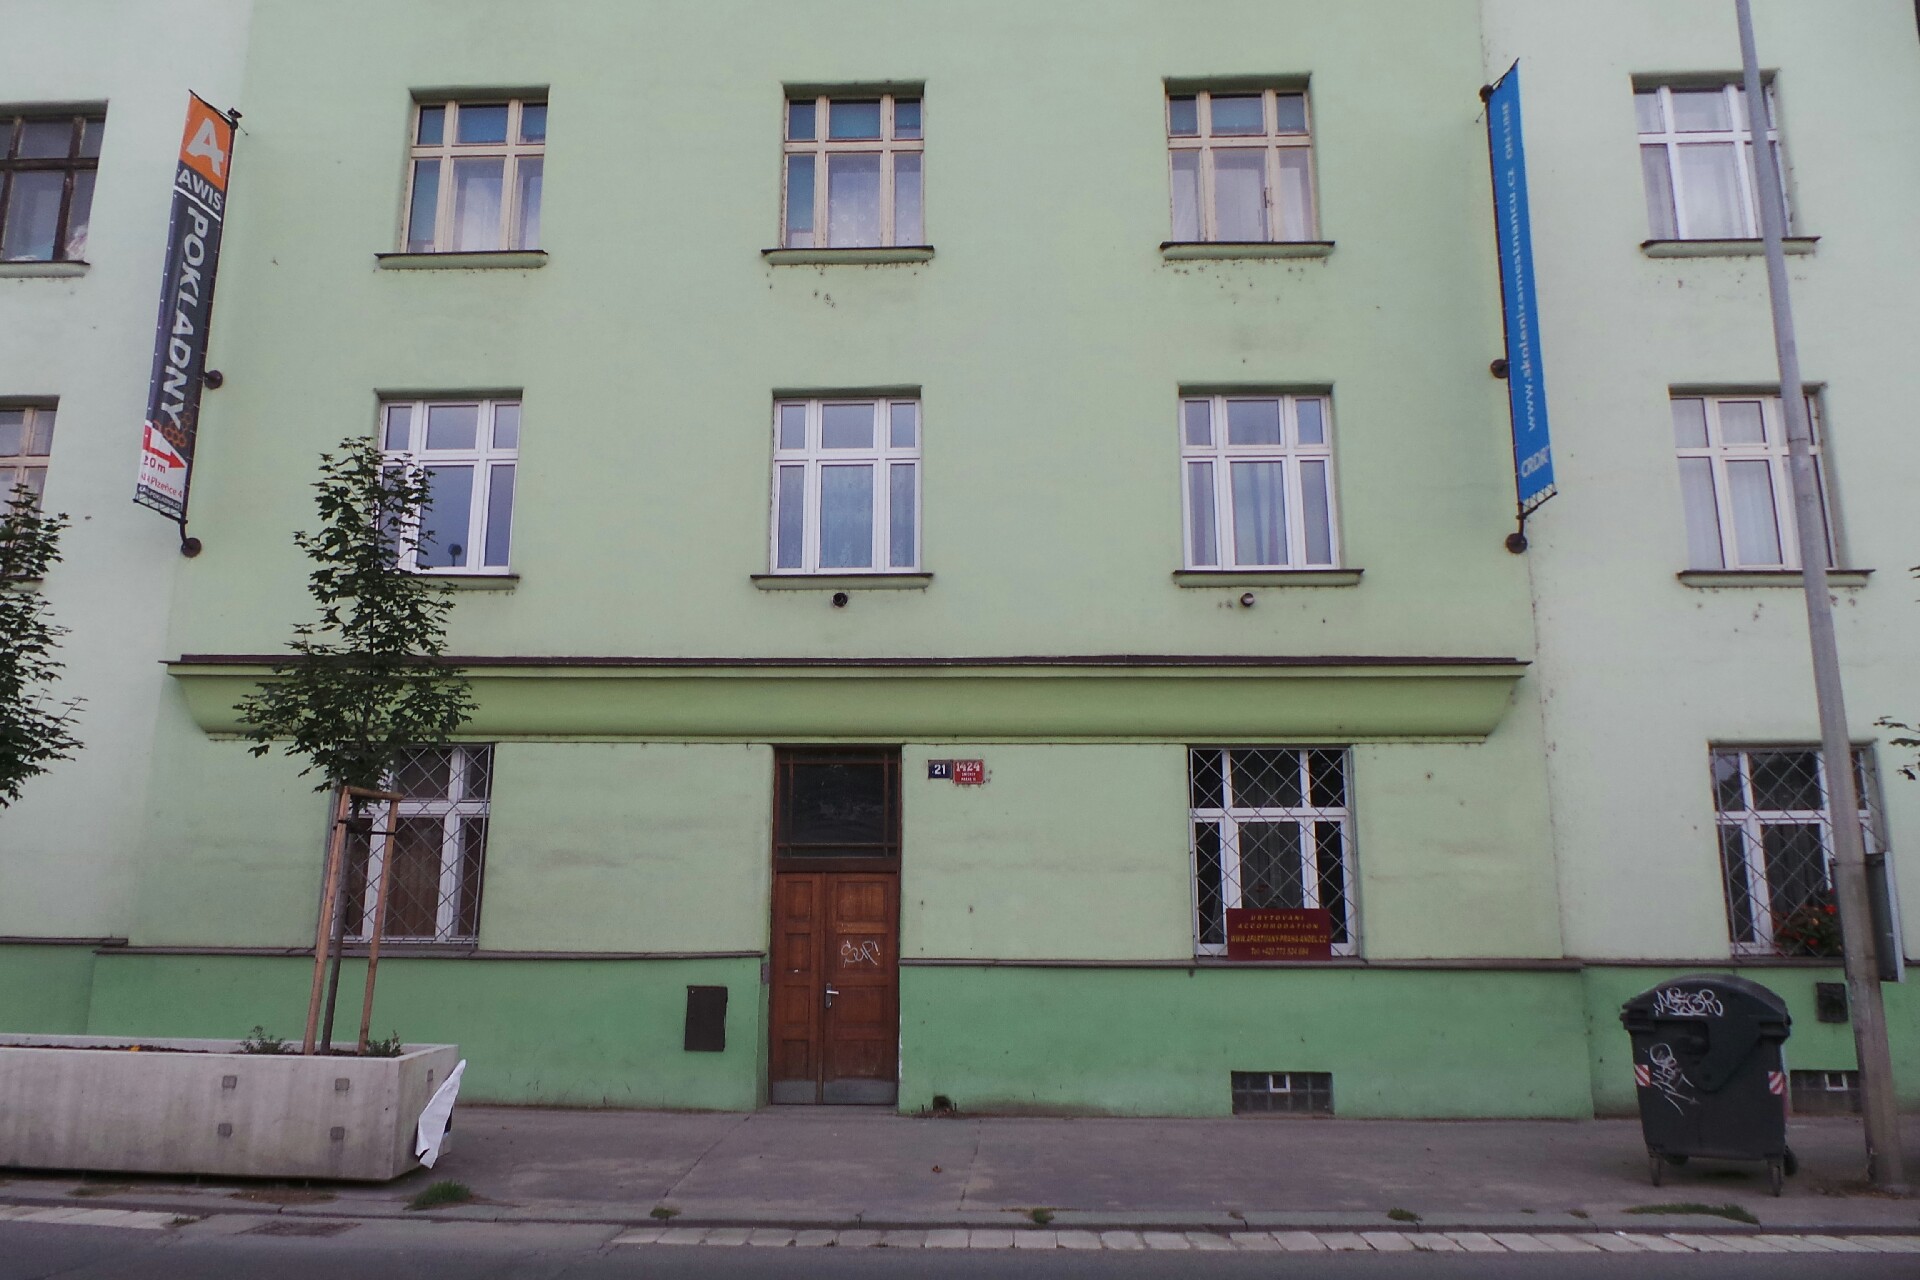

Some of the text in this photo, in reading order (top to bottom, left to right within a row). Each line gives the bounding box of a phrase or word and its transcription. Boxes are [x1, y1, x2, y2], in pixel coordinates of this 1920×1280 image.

[178, 169, 222, 211] AWIS
[161, 206, 209, 430] POKLADNY
[157, 463, 166, 474] m
[934, 764, 946, 775] 21
[956, 761, 980, 772] 1424
